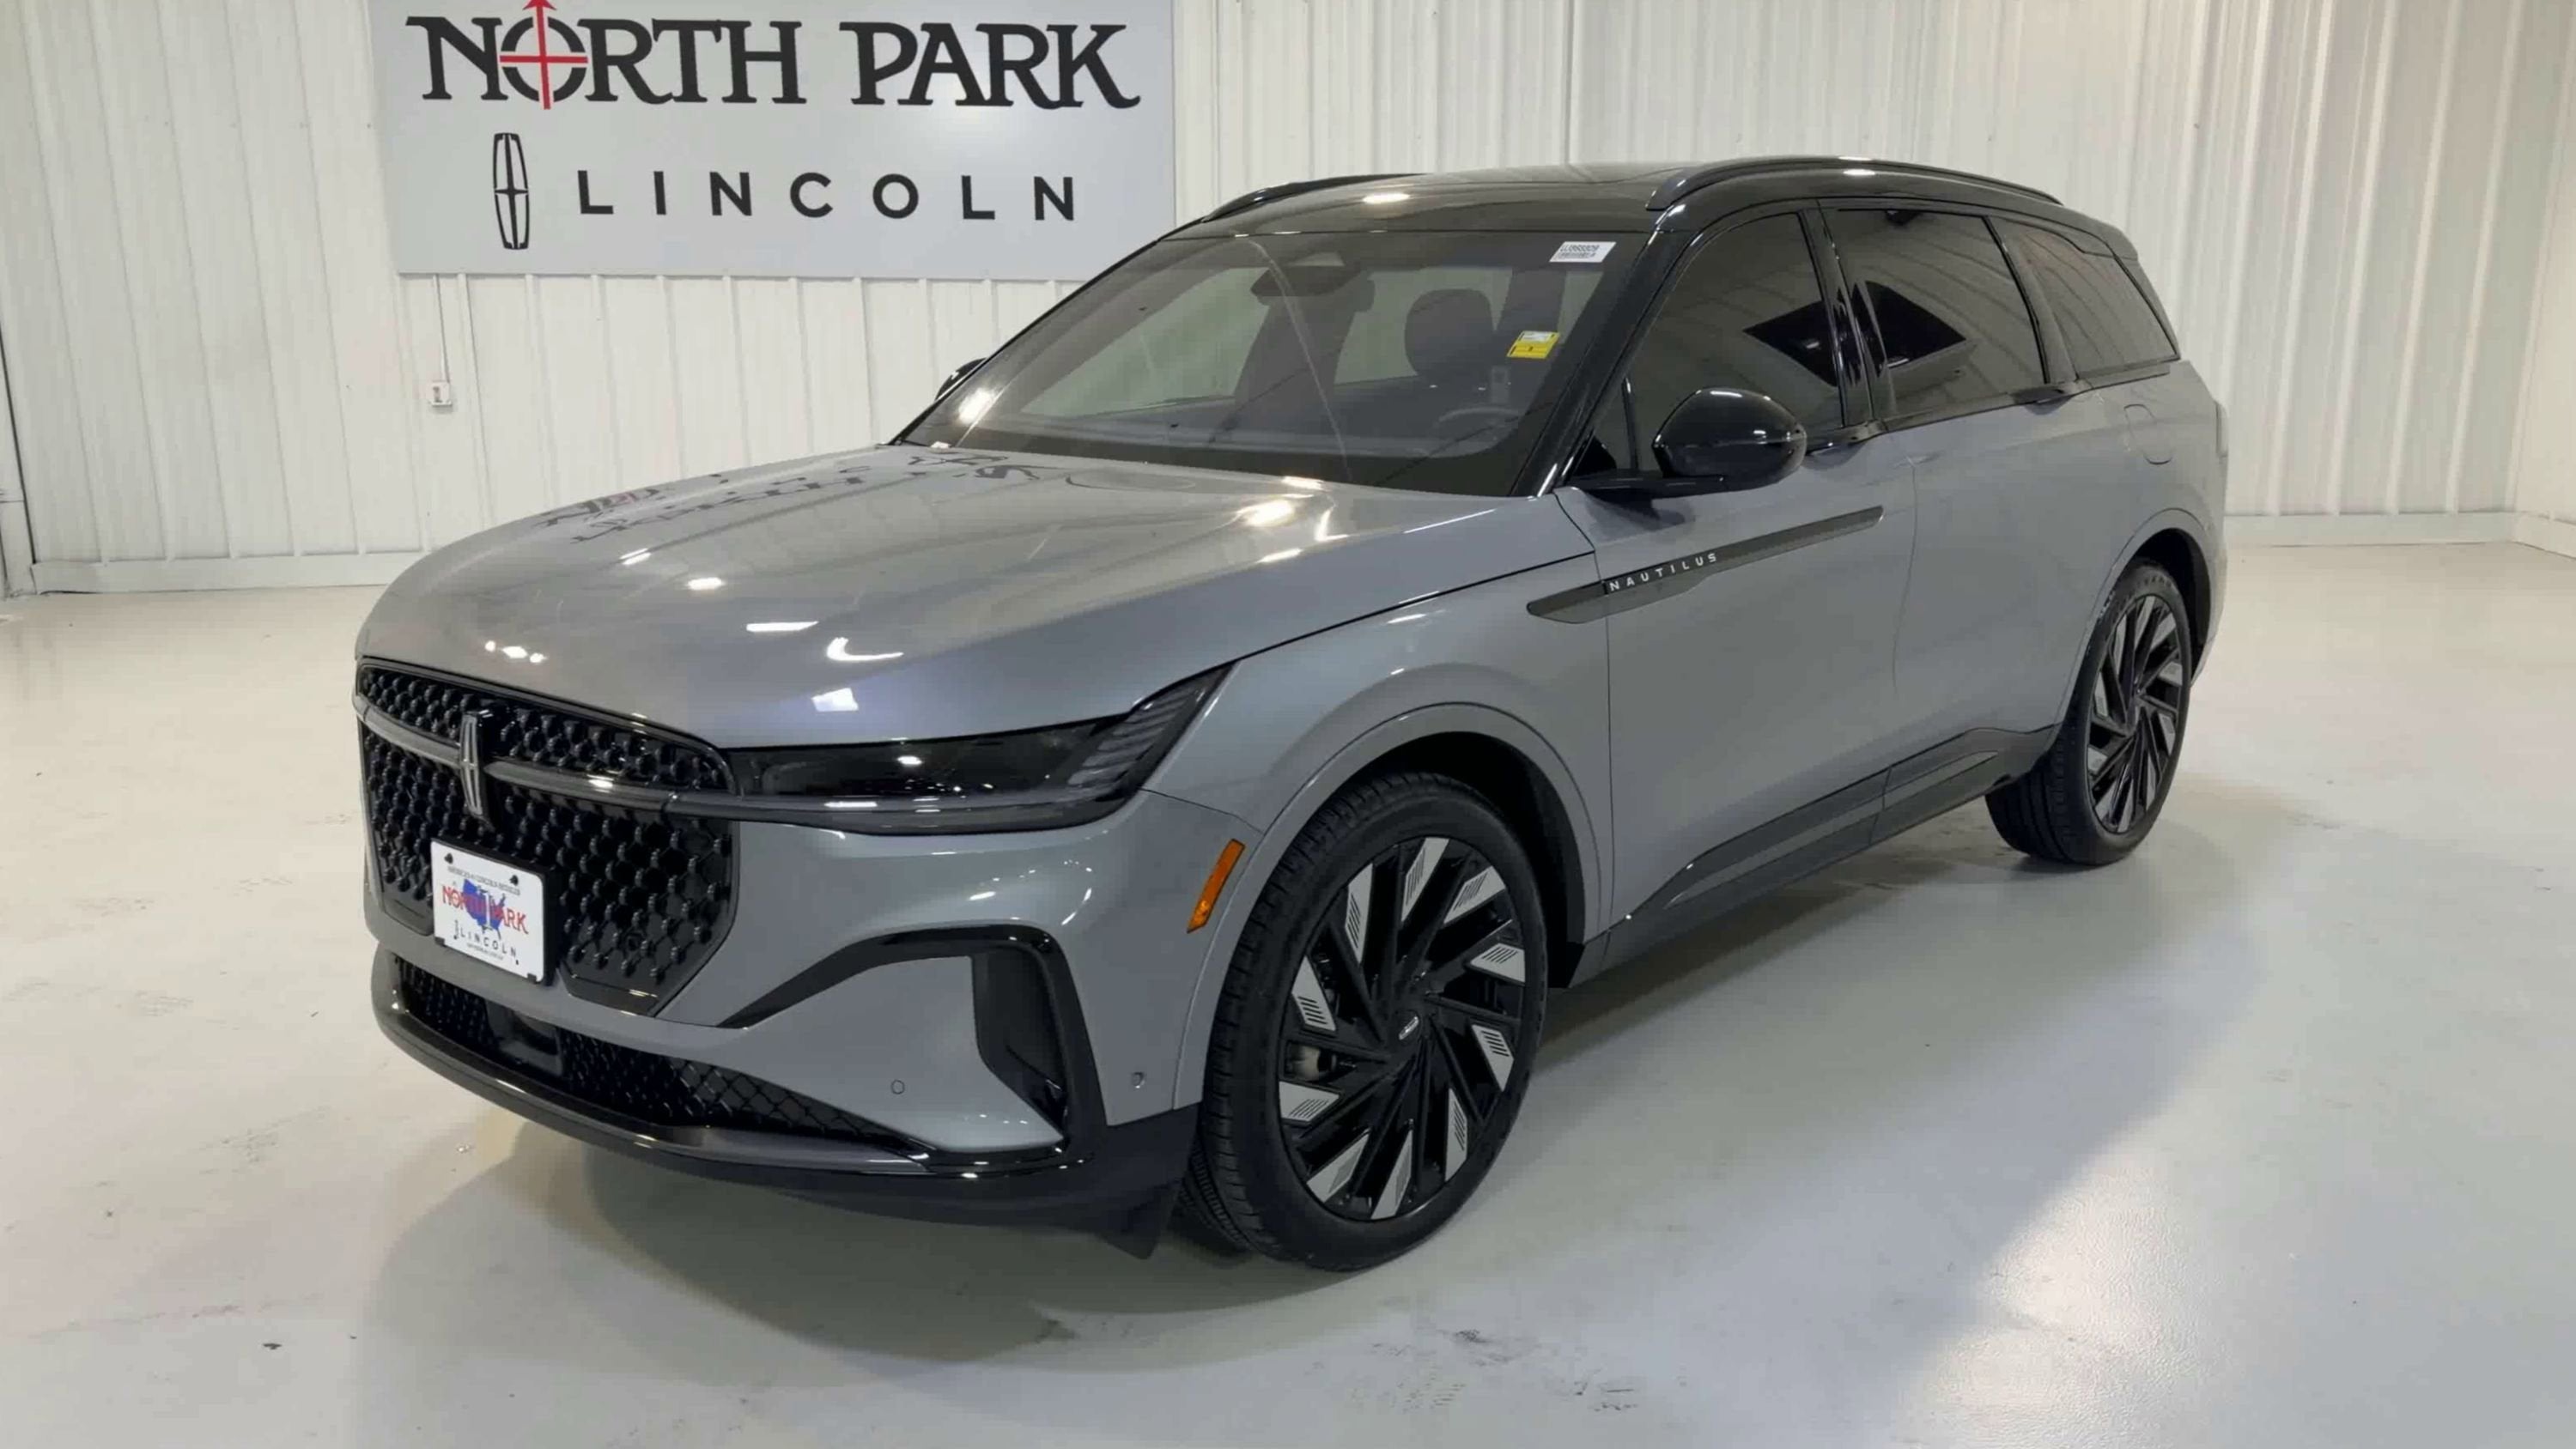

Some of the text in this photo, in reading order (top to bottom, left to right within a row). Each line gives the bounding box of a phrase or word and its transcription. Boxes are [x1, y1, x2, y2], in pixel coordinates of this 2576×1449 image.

[405, 16, 1141, 110] NORTH PARK
[578, 171, 1075, 221] LINCOLN
[1609, 552, 1717, 592] NAUTILUS
[460, 926, 515, 958] LINCOLN
